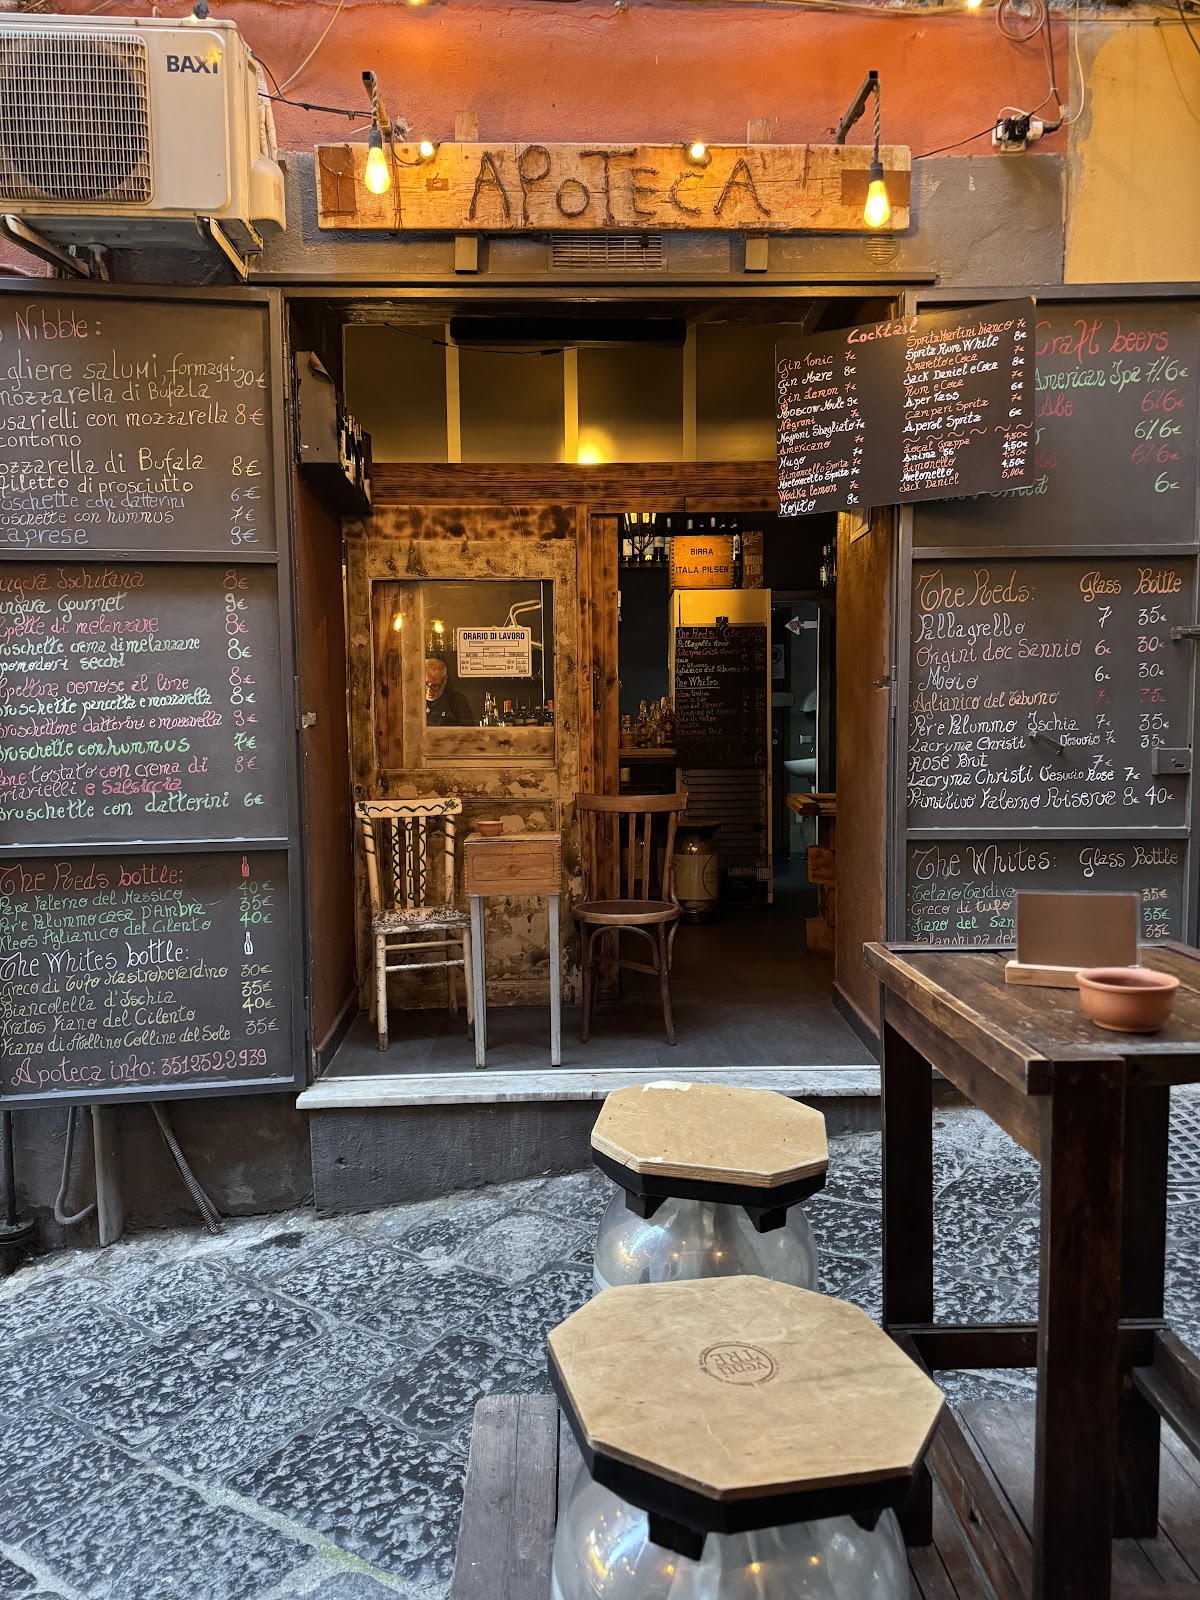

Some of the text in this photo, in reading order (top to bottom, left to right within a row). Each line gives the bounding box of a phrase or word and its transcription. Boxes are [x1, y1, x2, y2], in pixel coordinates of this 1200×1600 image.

[166, 55, 218, 74] BAXI
[15, 305, 101, 340] Nibble:
[937, 343, 961, 355] Rum
[963, 336, 999, 351] White
[1108, 319, 1168, 353] beers
[167, 353, 267, 388] formaggi 20€
[777, 359, 801, 379] Gin
[804, 352, 833, 366] Tonic
[778, 378, 798, 394] Gin
[844, 366, 856, 376] 8€
[122, 382, 211, 407] di Bufala
[778, 393, 801, 410] Gin
[86, 404, 265, 427] con mozzarella 8€
[105, 447, 261, 477] di Bufala 8€
[778, 456, 806, 470] Hugo
[943, 448, 954, 456] 56
[78, 475, 193, 500] di prosciutto
[1155, 472, 1180, 492] 6€
[86, 486, 261, 509] con 6€
[847, 493, 859, 504] 8€
[74, 510, 101, 523] con
[230, 507, 256, 523] 7€
[223, 569, 249, 590] 8€
[915, 568, 1181, 611] The Glass Bottle
[58, 592, 247, 623] Gourmet 9€
[1098, 606, 1112, 628] 7
[51, 618, 68, 634] di
[225, 613, 249, 634] 8€
[227, 638, 251, 660] 8€
[916, 644, 977, 672] Origini
[983, 639, 1012, 661] doc
[1018, 639, 1082, 658] Sannio
[80, 653, 125, 670] secchi
[229, 666, 255, 686] 8€
[230, 685, 256, 704] 8€
[984, 690, 1005, 708] del
[150, 709, 258, 728] e 9€
[233, 731, 256, 751] 7€
[977, 735, 1026, 751] Christi
[100, 763, 131, 778] con
[135, 763, 180, 777] crema
[188, 756, 208, 773] di
[235, 756, 259, 773] 8€
[975, 765, 1034, 785] Christi
[85, 783, 95, 795] e
[103, 791, 265, 816] con datterini 6€
[912, 844, 1178, 880] The Whites: Glass Bottle
[0, 863, 45, 896] The
[118, 863, 183, 887] bottle:
[93, 881, 274, 905] del 40€
[240, 896, 274, 912] 35€
[911, 903, 950, 915] Greco
[957, 901, 971, 913] di
[42, 910, 273, 950] Aglianico del Cilento 40€
[957, 917, 979, 928] del
[0, 939, 189, 981] The Whites bottle:
[2, 964, 273, 1002] Greco di 30€
[1, 980, 273, 1019] Biancolella 35€
[103, 997, 275, 1029] del Cilento 40€
[48, 1018, 279, 1052] di Colline del Sole 35€
[11, 1057, 105, 1087] Apoteca
[710, 1350, 762, 1366] TRE
[720, 1361, 770, 1378] venti
